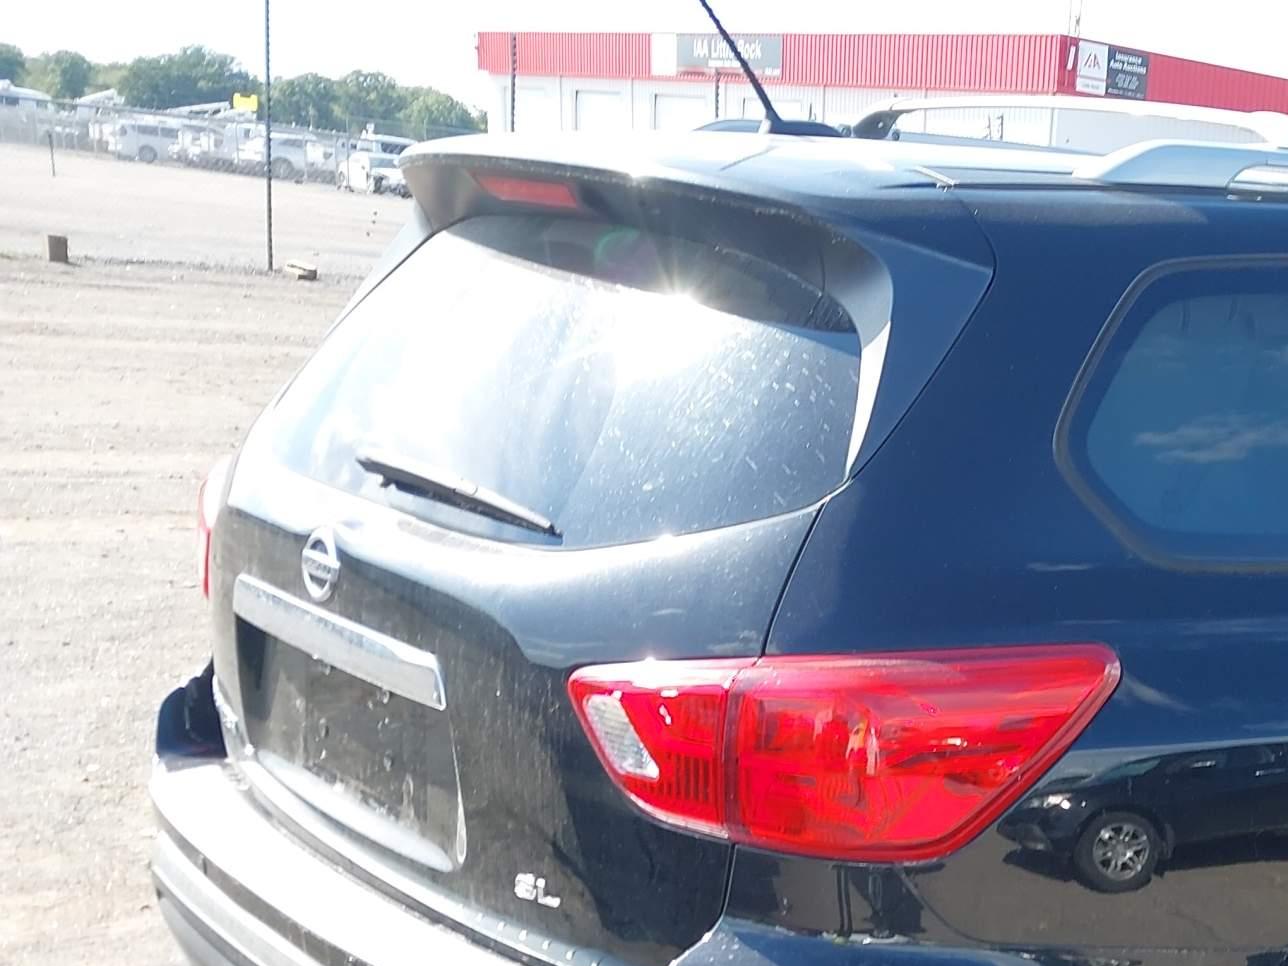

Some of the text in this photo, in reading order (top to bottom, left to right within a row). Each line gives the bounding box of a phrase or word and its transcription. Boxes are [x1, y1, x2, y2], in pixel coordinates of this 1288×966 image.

[693, 39, 709, 58] IAA
[737, 39, 762, 60] Rock
[1109, 58, 1147, 75] Auto Auctions
[514, 872, 561, 909] SL
